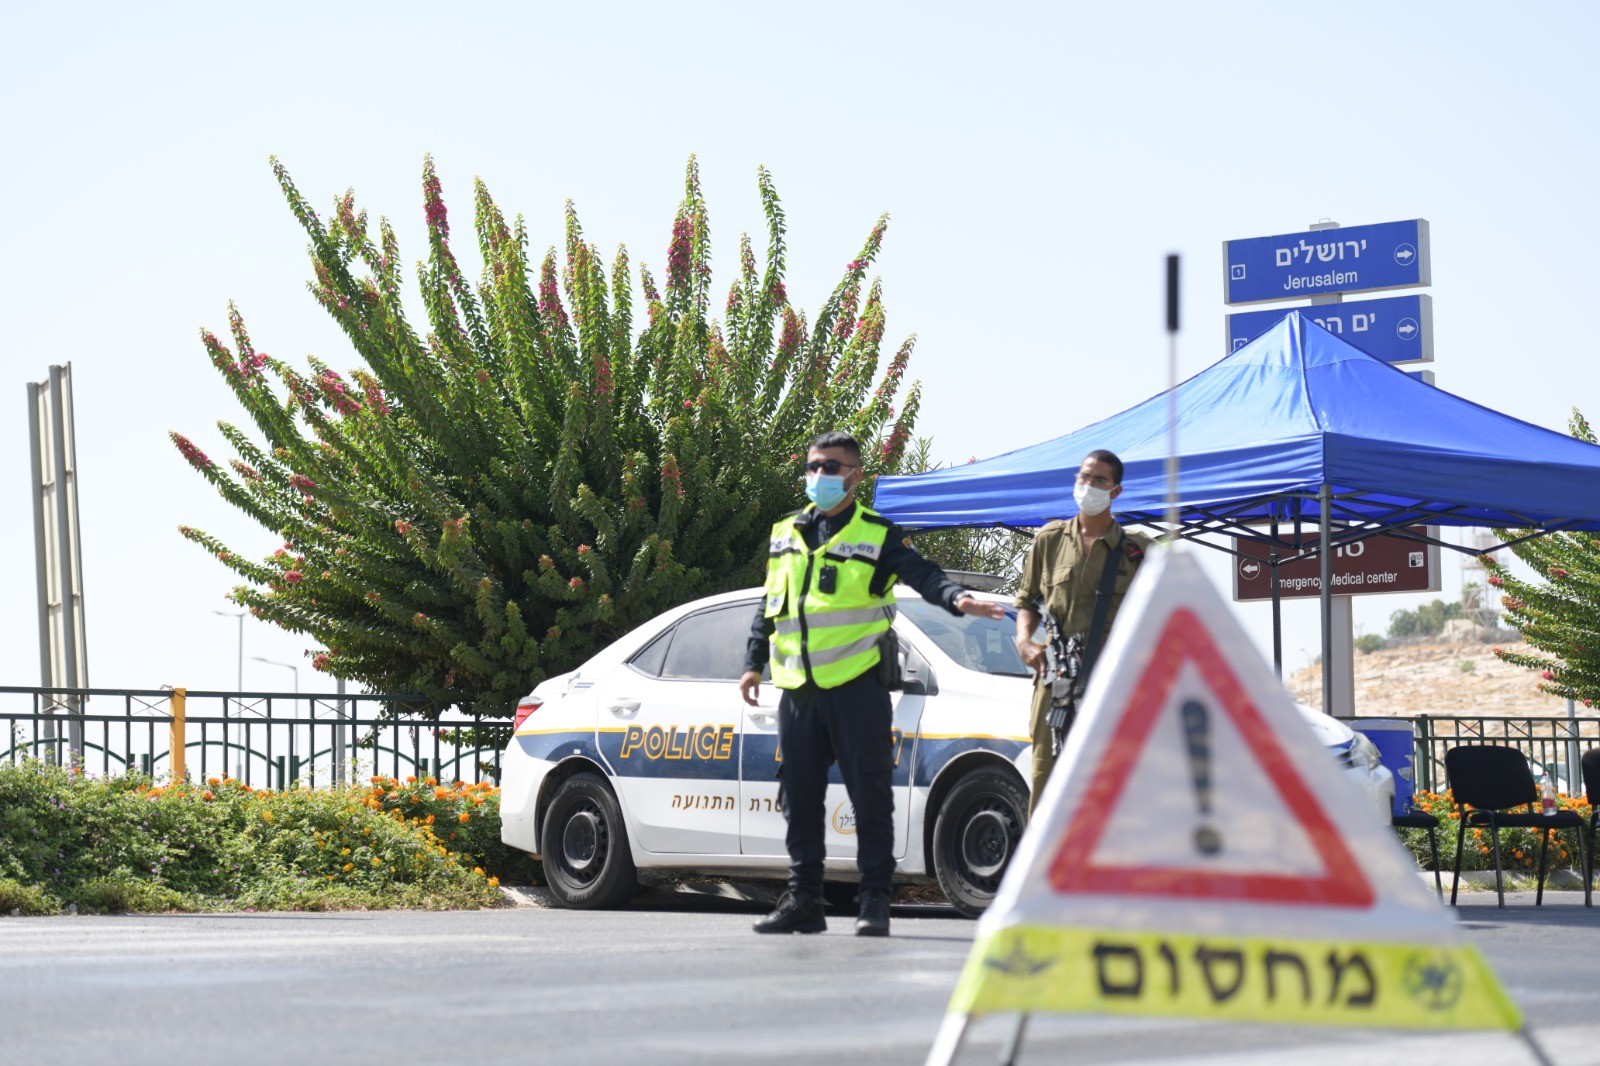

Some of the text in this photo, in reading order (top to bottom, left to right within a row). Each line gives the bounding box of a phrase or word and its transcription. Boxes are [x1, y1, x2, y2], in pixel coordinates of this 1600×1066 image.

[1276, 239, 1367, 267] ירושלים
[1283, 270, 1358, 290] Jerusalem
[1352, 312, 1376, 333] ים
[1270, 576, 1322, 591] mergency
[1366, 571, 1398, 584] center
[619, 723, 736, 761] POLICE
[671, 794, 735, 811] התנועה
[1091, 940, 1379, 1007] מחסום
